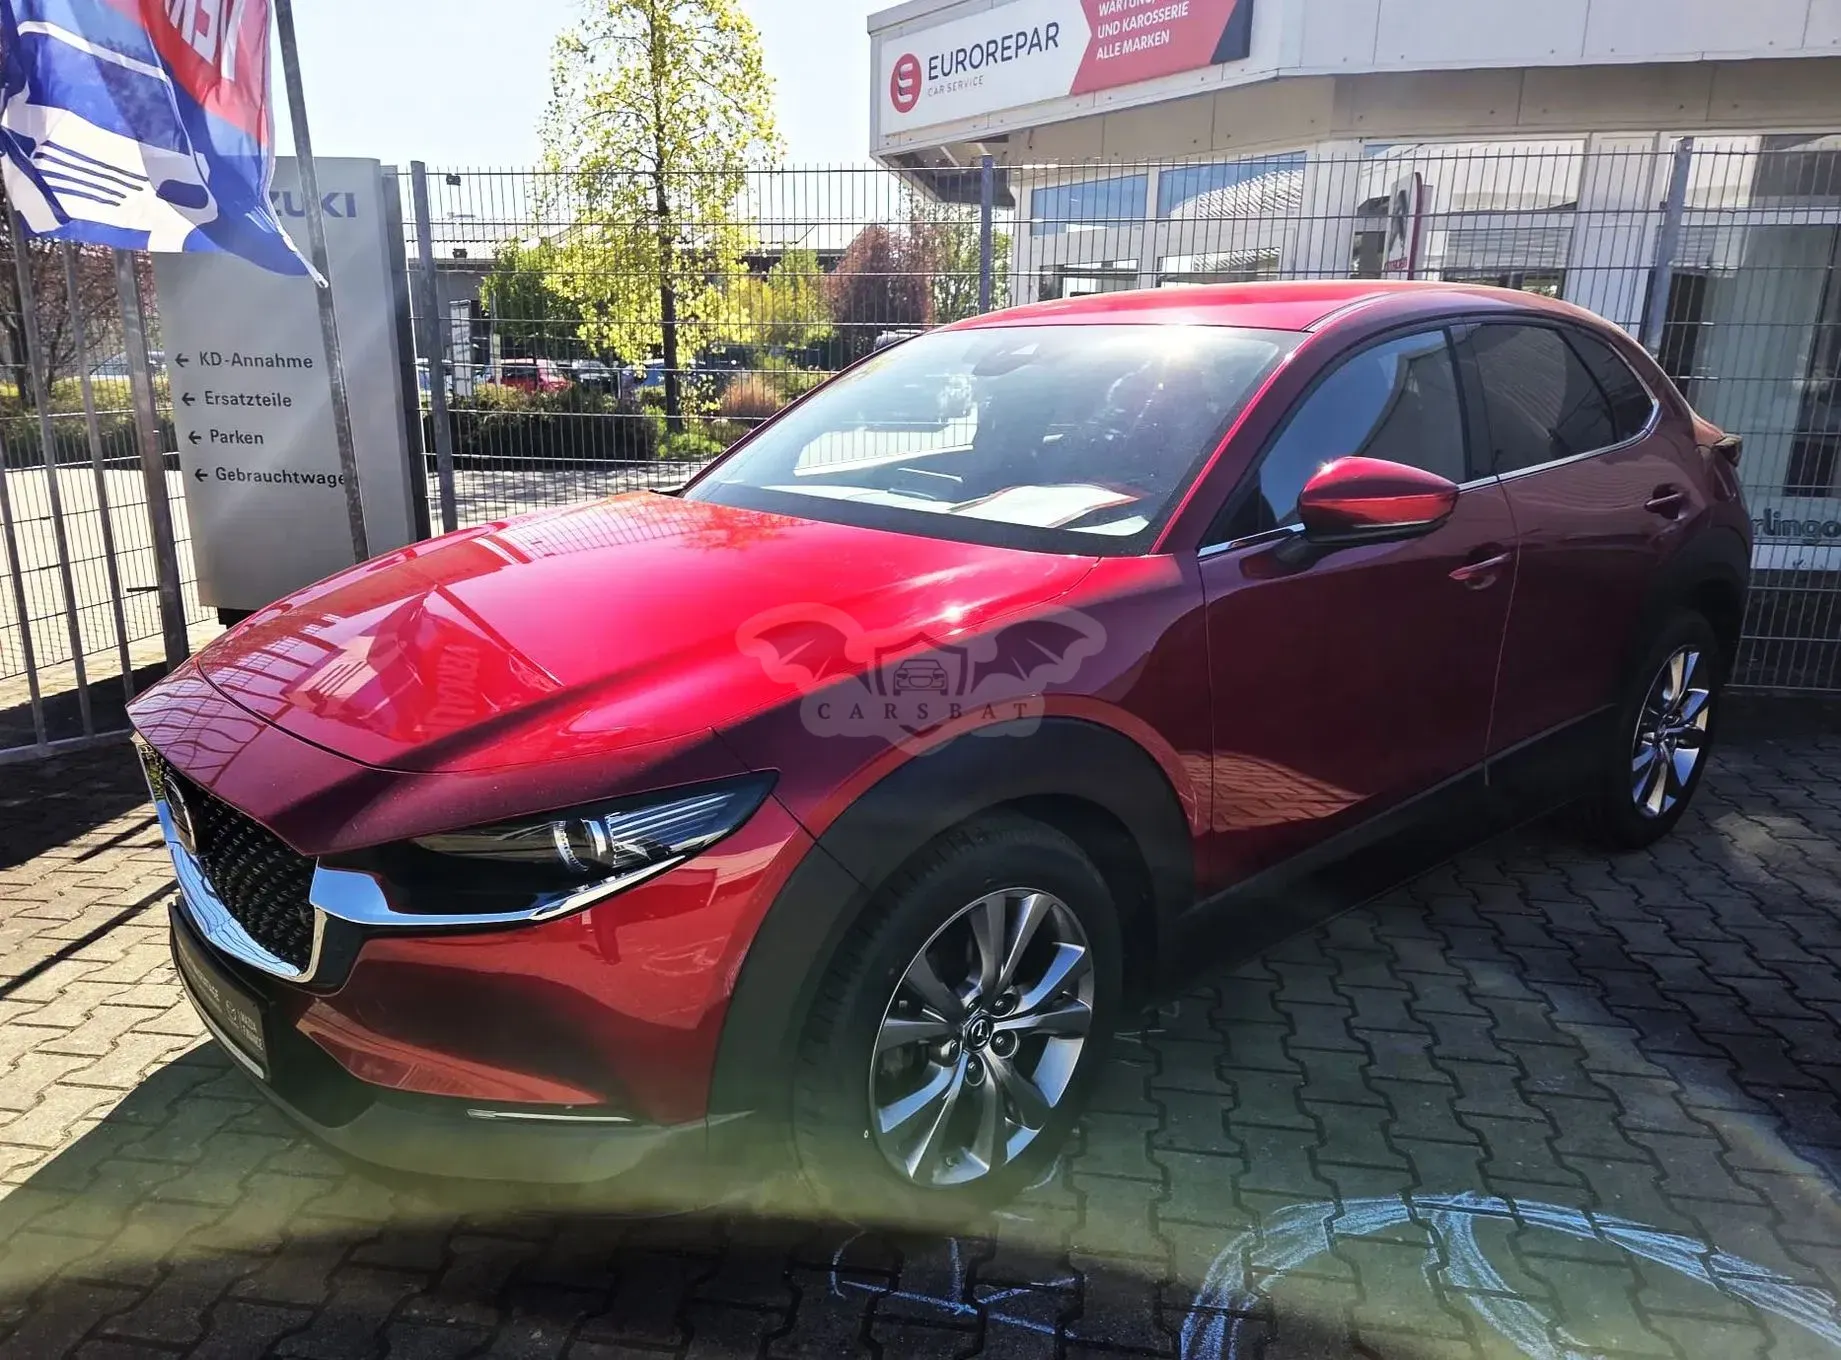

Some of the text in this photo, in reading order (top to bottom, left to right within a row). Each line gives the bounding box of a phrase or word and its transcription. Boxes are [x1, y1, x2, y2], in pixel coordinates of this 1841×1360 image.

[1097, 1, 1190, 39] UND KAROSSERIE
[928, 21, 1060, 81] EUROREPAR
[1096, 29, 1170, 61] ALLE MARKEN
[927, 75, 984, 98] CAR SERVICE
[199, 351, 314, 369] KD-Annahme
[204, 390, 293, 408] Ersatzteile
[209, 428, 264, 445] Parken
[215, 466, 346, 489] Gebrauchtwage
